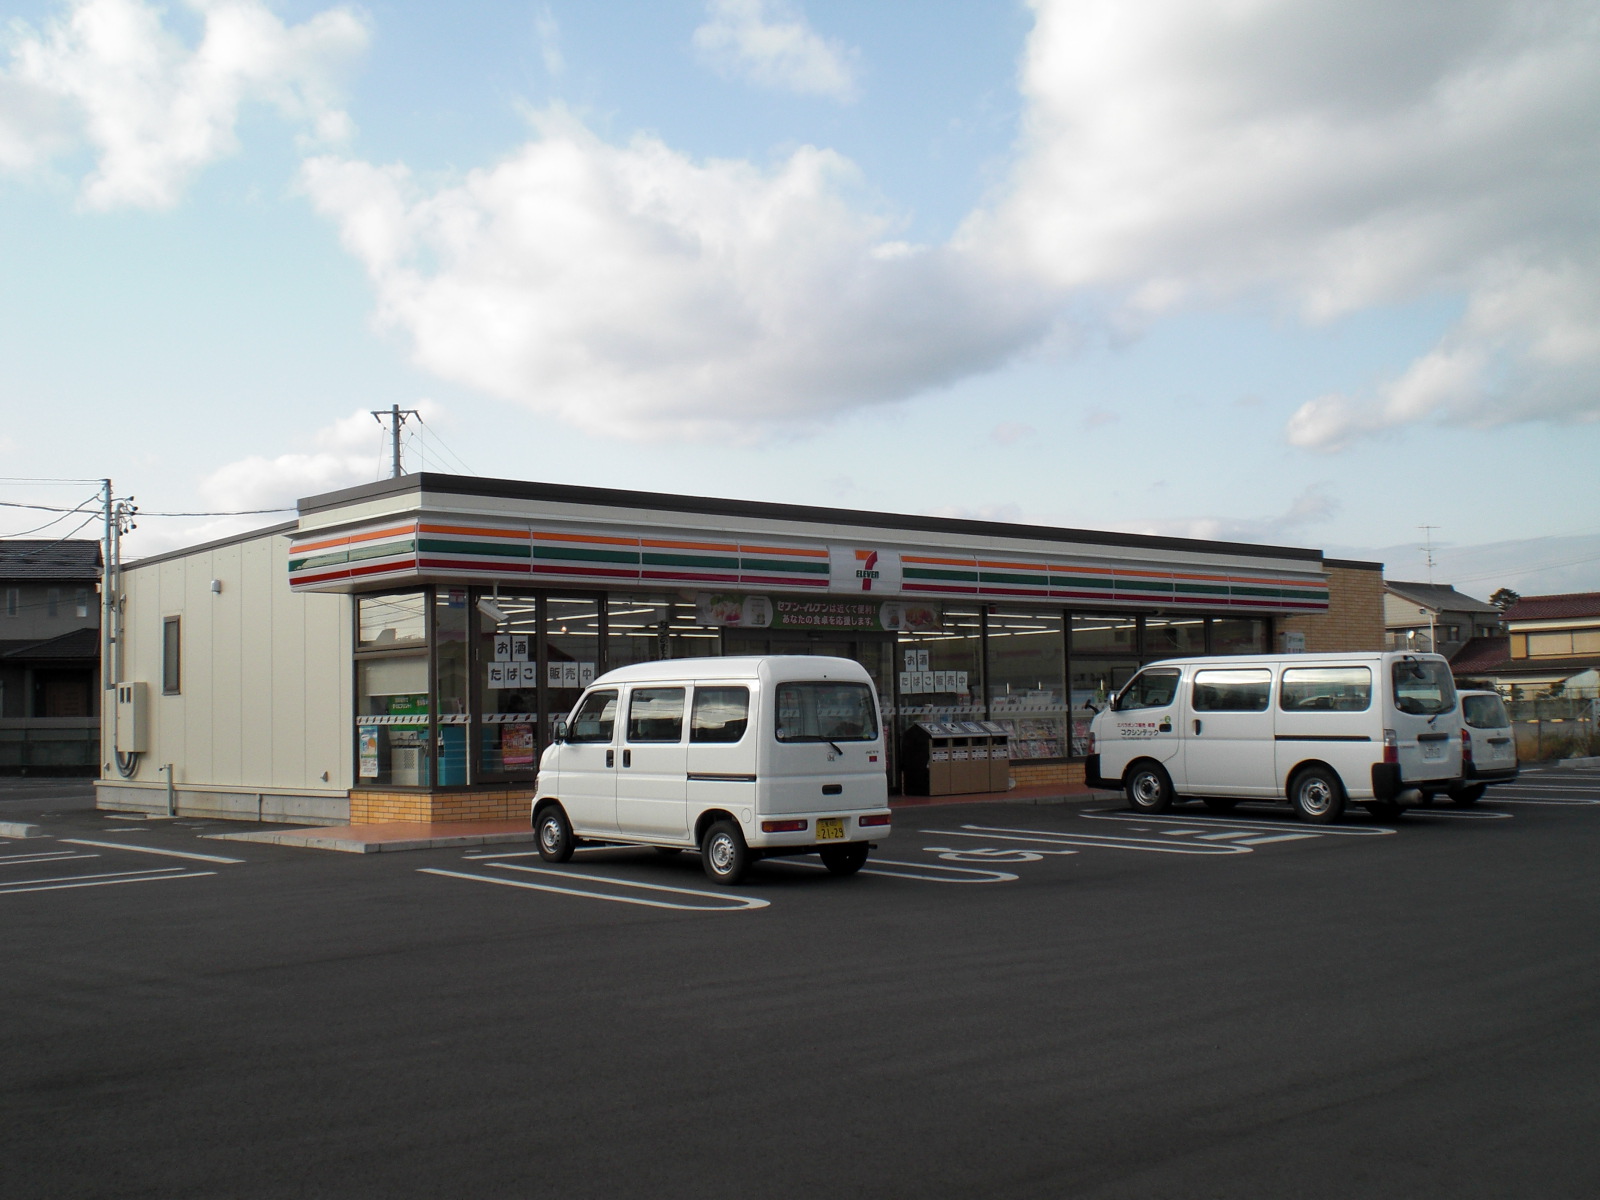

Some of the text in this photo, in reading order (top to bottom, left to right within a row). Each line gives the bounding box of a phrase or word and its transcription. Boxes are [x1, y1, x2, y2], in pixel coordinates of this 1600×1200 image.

[855, 550, 878, 590] 7
[497, 641, 526, 655] お酒
[907, 654, 927, 666] お酒
[491, 667, 592, 681] たばこ 販売中
